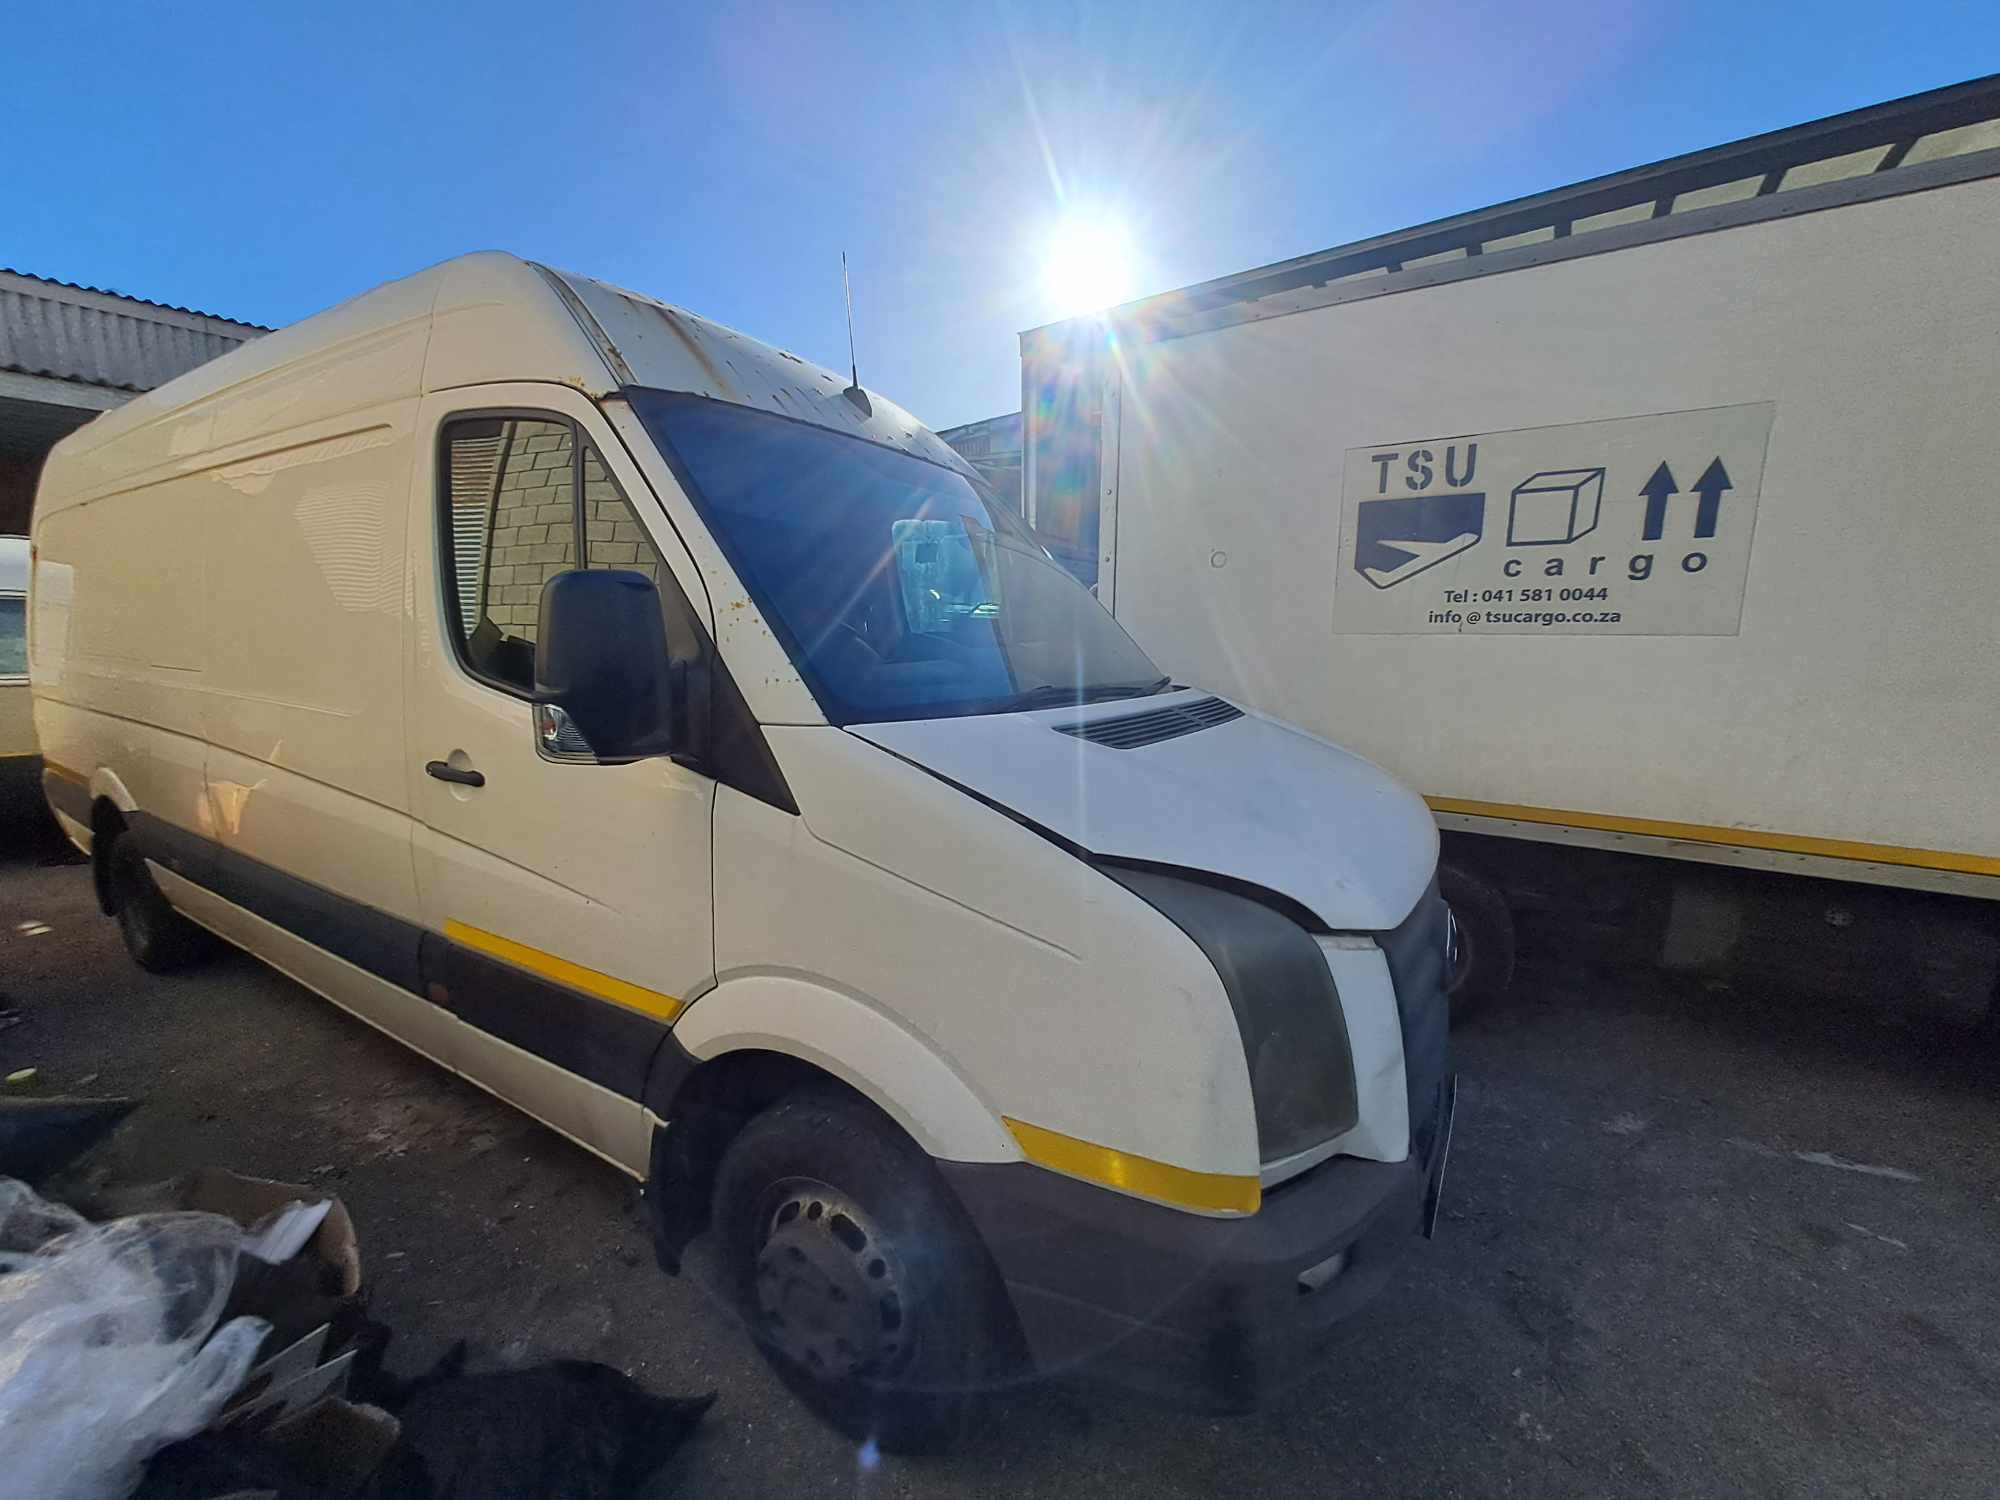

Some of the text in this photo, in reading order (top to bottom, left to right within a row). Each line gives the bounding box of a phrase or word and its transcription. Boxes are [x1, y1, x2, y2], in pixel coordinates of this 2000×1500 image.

[1371, 443, 1478, 494] TSU
[1503, 552, 1709, 581] cargo
[1481, 589, 1513, 602] 041
[1519, 588, 1553, 602] 581
[1559, 587, 1608, 601] 0044
